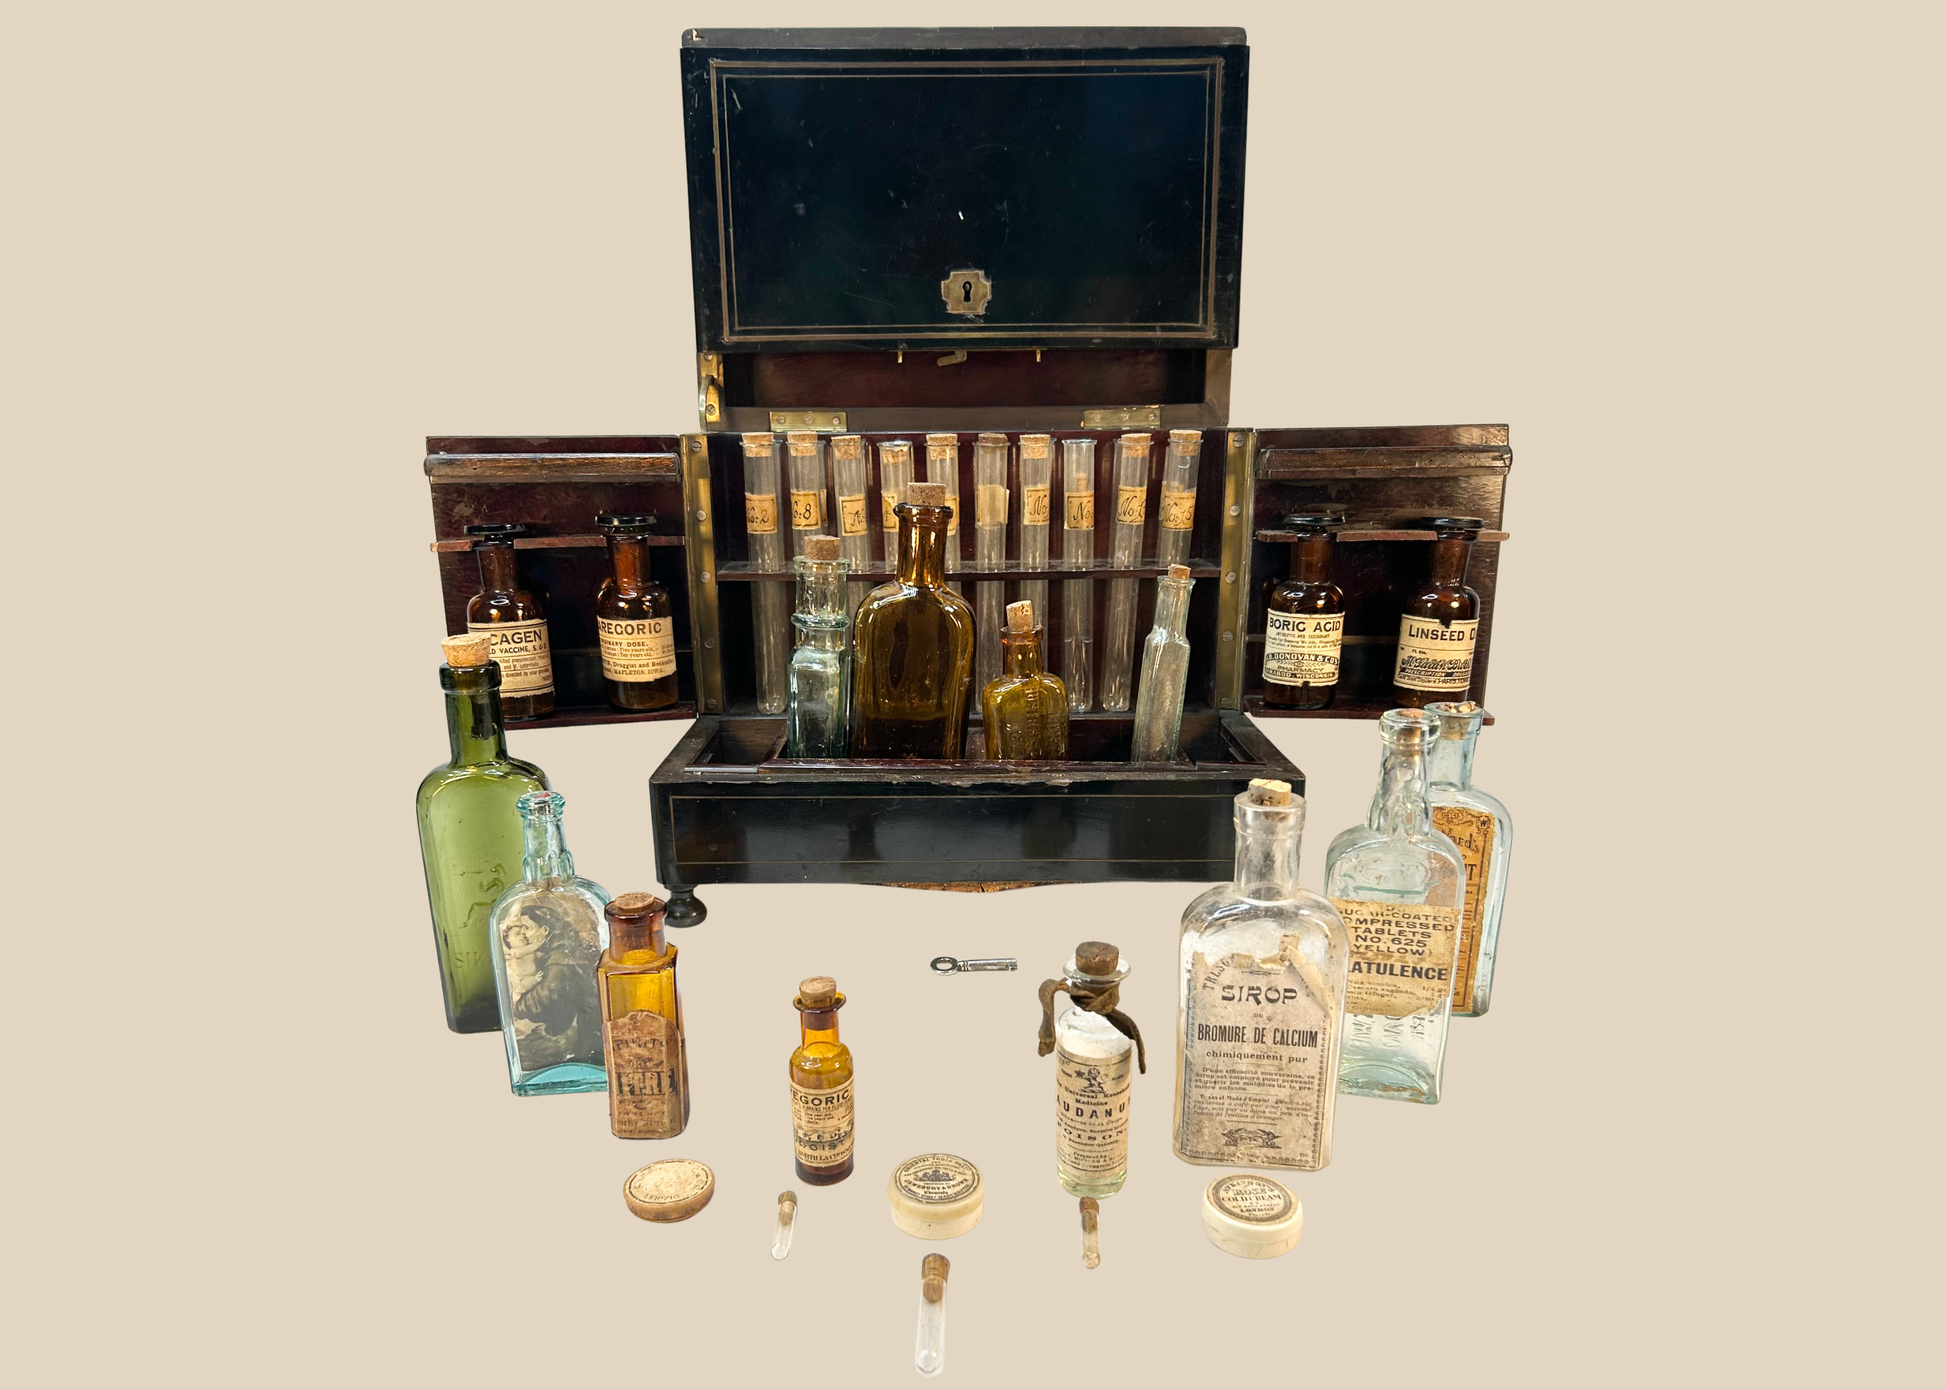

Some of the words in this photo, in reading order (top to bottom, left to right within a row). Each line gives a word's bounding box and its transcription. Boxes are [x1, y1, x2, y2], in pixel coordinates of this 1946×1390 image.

[1269, 617, 1306, 632] BORIC
[1313, 620, 1341, 632] ACID
[1408, 624, 1465, 641] LINSEED
[499, 646, 531, 654] VACCINE,
[613, 661, 637, 669] Druggist
[1351, 926, 1432, 939] TABLETS
[1355, 934, 1387, 944] NO.
[1391, 937, 1427, 948] 625
[1353, 943, 1433, 956] YELLOW)
[1349, 961, 1449, 981] ATULENCE
[1221, 984, 1298, 1006] SIROP
[1197, 1023, 1247, 1043] BROMURE
[1253, 1026, 1267, 1044] DE
[1272, 1027, 1318, 1048] CALCIUM
[1206, 1050, 1283, 1062] chimiquement
[1288, 1055, 1308, 1064] pur
[1195, 1072, 1216, 1080] Sirop
[1242, 1081, 1276, 1089] maladies
[790, 1089, 850, 1107] EGORIC
[1064, 1086, 1098, 1099] Universal
[1057, 1094, 1130, 1119] UDANU
[1075, 1098, 1108, 1106] Medicine
[1249, 1193, 1282, 1202] CREAM
